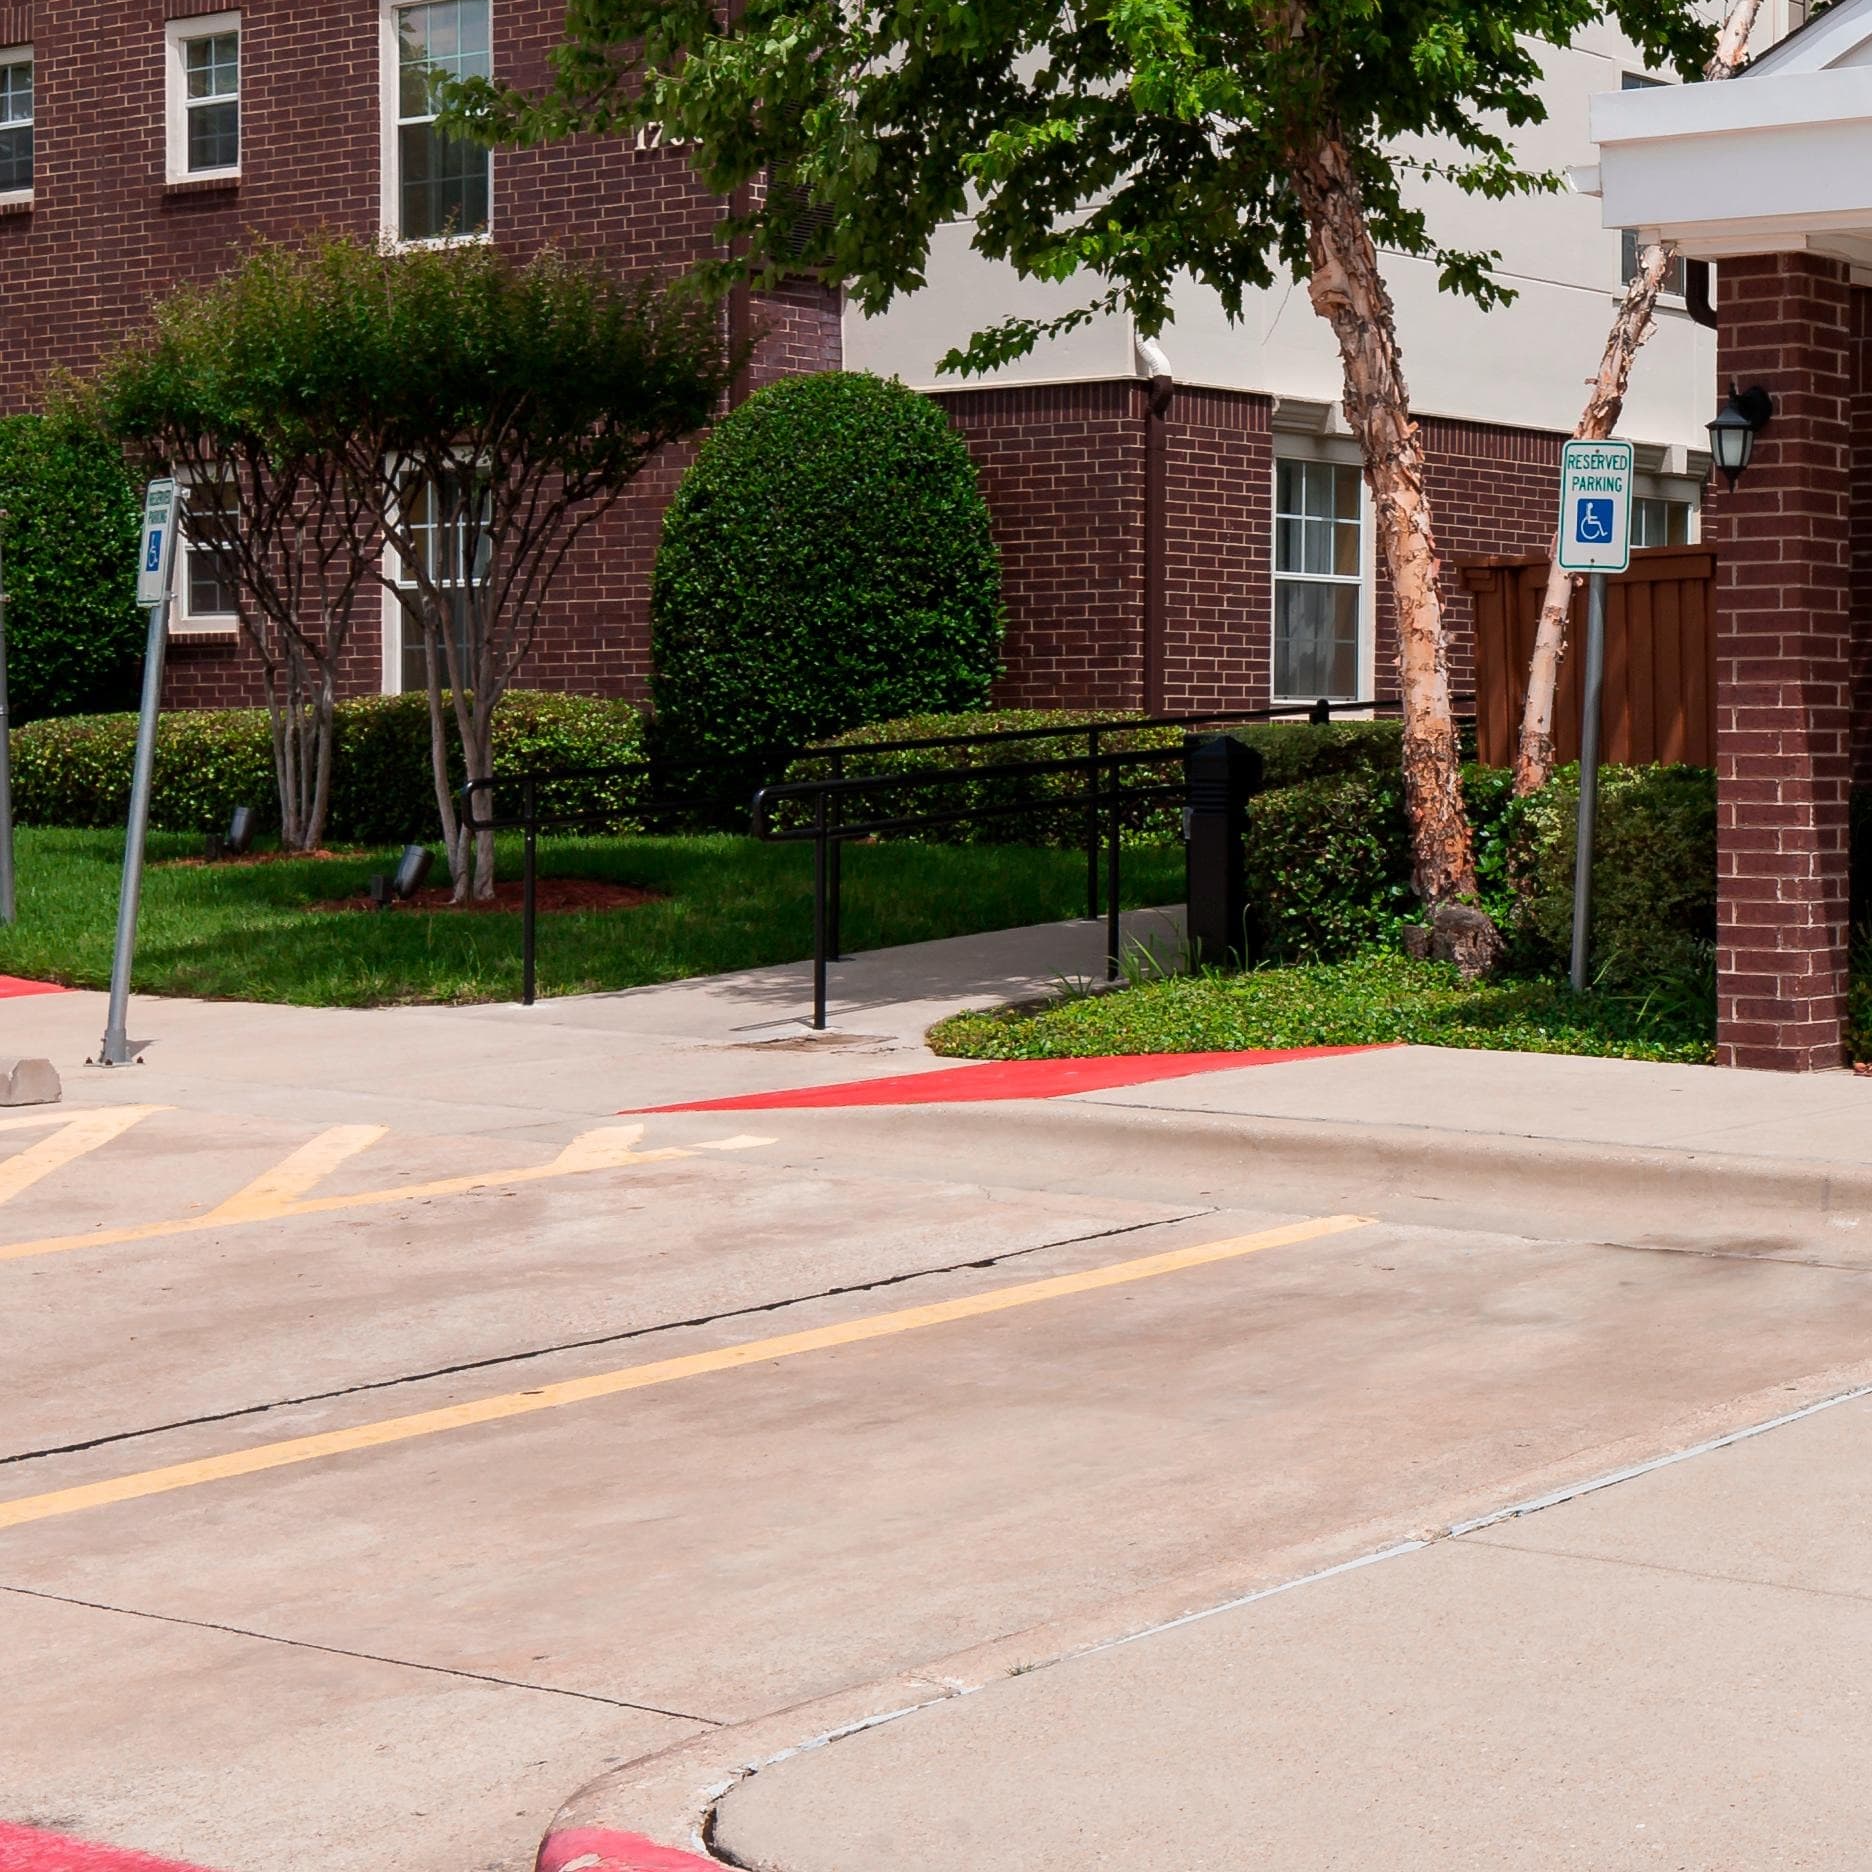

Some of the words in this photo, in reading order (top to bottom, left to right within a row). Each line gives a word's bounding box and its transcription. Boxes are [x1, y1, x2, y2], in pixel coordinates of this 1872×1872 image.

[634, 118, 705, 151] 17
[1567, 454, 1628, 471] RESERVED
[1571, 476, 1623, 493] PARKING
